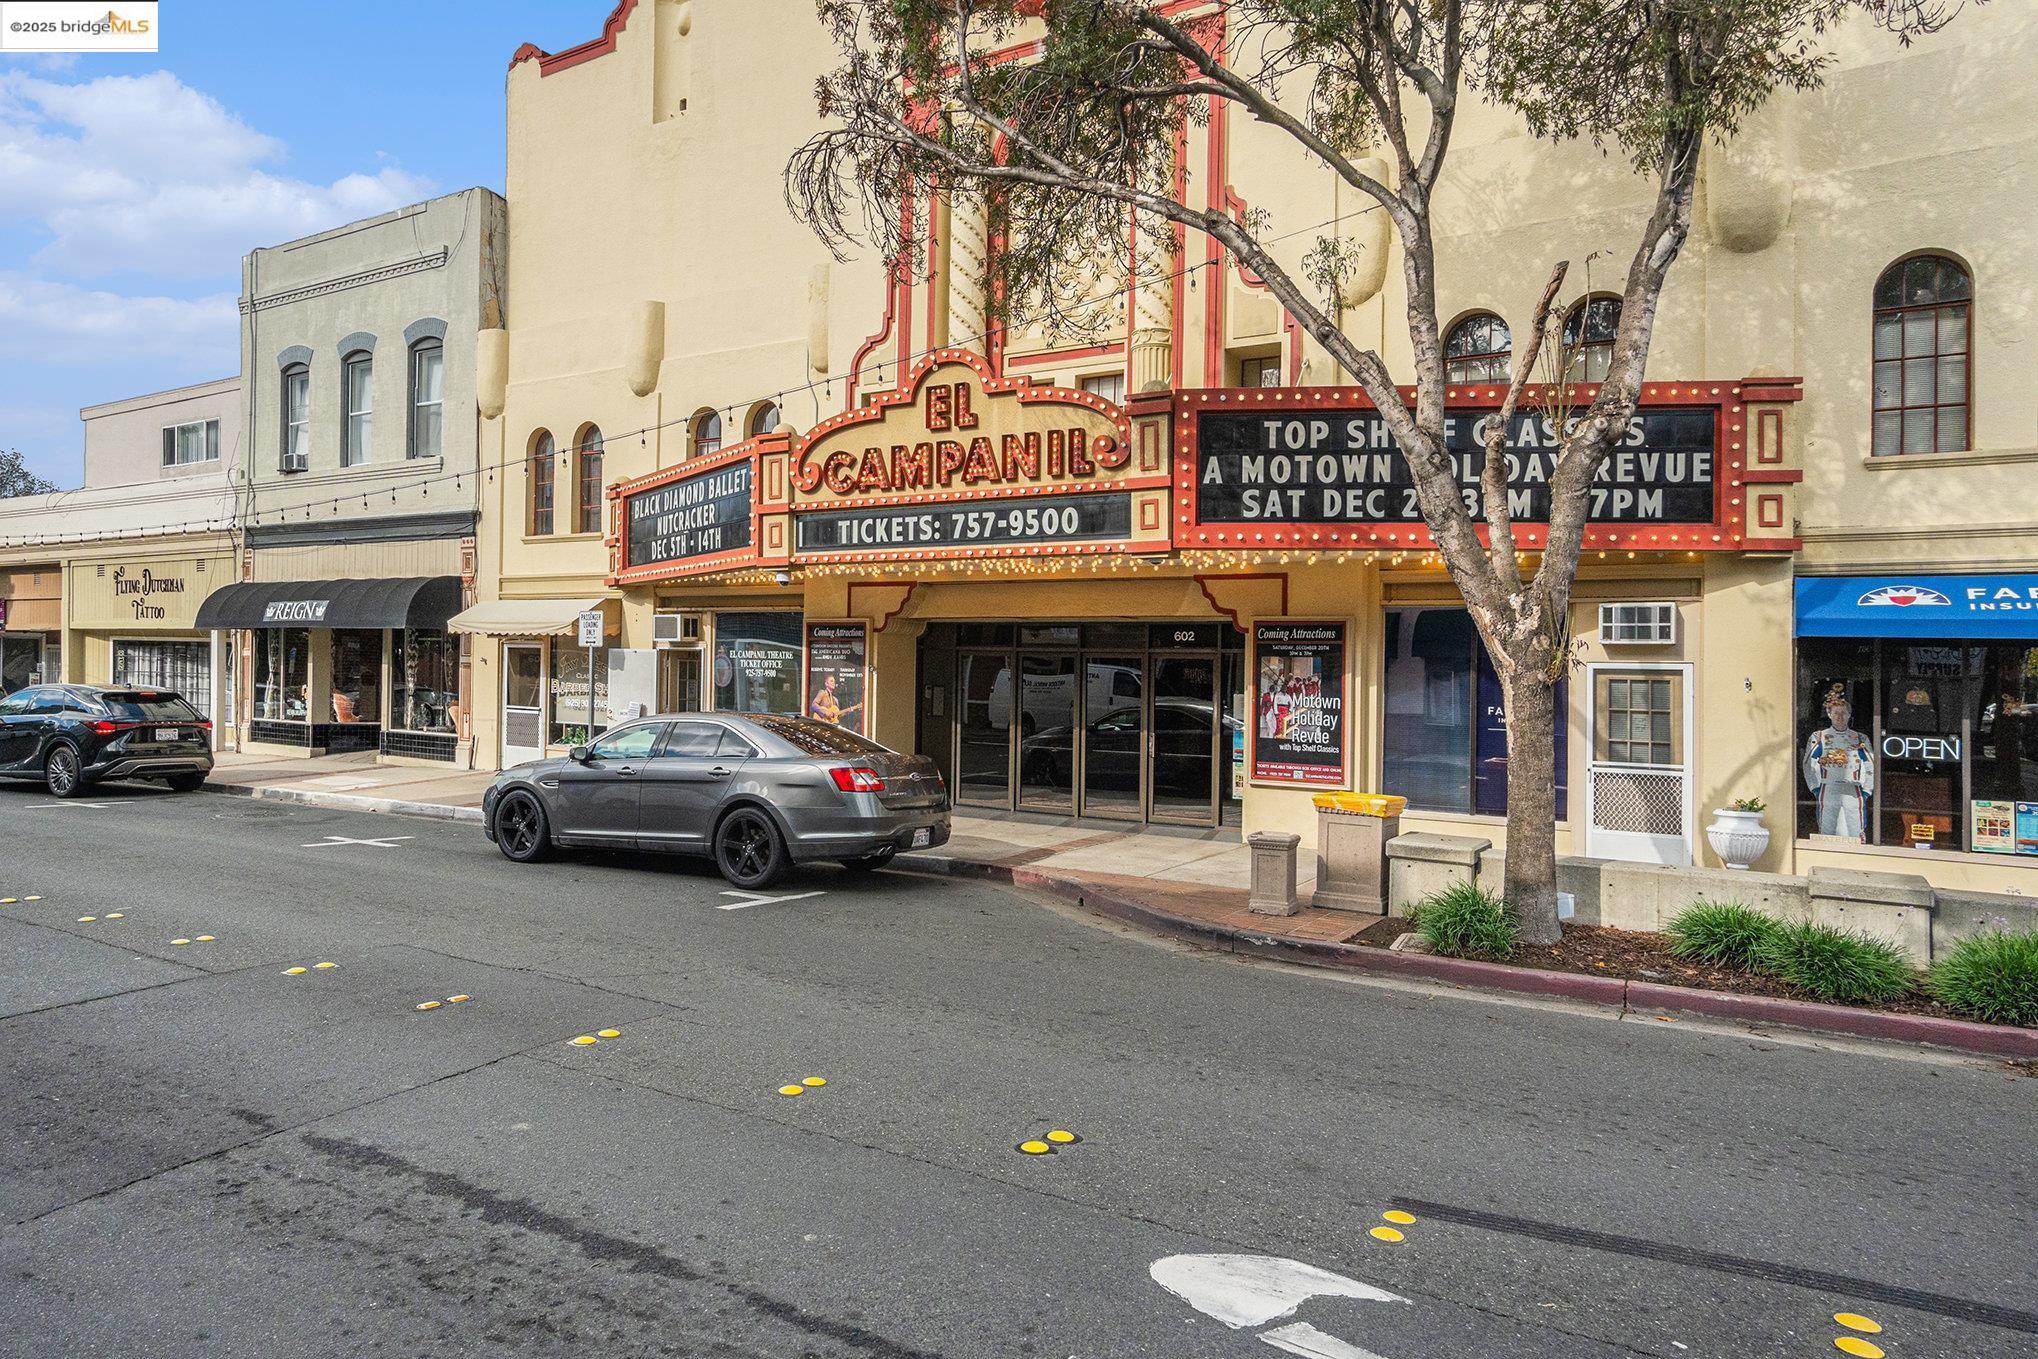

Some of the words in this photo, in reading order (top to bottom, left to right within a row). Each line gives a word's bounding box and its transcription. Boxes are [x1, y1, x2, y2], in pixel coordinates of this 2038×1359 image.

[925, 381, 979, 430] EL
[1264, 420, 1329, 449] TOP
[1346, 419, 1456, 448] SHF
[822, 427, 1094, 493] CAMPANIL
[1203, 455, 1223, 484] A
[1241, 454, 1391, 484] MOTOWN
[1593, 452, 1711, 482] REVUE
[634, 494, 660, 519] BLACK
[664, 481, 705, 511] DIAMOND
[708, 468, 747, 499] BALLET
[1242, 489, 1305, 518] SAT
[1323, 489, 1385, 518] DEC
[1462, 488, 1532, 517] 3M
[1590, 489, 1663, 518] 7PM
[657, 503, 715, 536] NUTCRACKER
[838, 515, 940, 544] TICKETS:
[952, 506, 1079, 539] 757-9500
[651, 539, 667, 560] DEC
[670, 534, 686, 557] 5TH
[698, 527, 720, 552] 14TH
[113, 566, 140, 596] FLYING
[142, 568, 184, 596] DUTCHMAN
[131, 597, 165, 620] TATTOO
[274, 600, 317, 619] REIGN
[1970, 602, 2038, 610] INSU
[814, 627, 835, 638] Coming
[835, 627, 864, 637] Attractions
[1174, 631, 1195, 641] 602
[1258, 628, 1289, 641] Coming
[1290, 628, 1336, 639] Attractions
[730, 650, 737, 658] EL
[737, 650, 766, 659] CAMPANIL
[767, 651, 794, 659] THEATRE
[740, 659, 761, 668] TICKET
[762, 660, 783, 668] OFFICE
[745, 669, 777, 678] 925-757-9500
[594, 682, 608, 693] SH
[1292, 692, 1341, 709] Motown
[1292, 710, 1338, 730] Holiday
[1488, 706, 1504, 716] FA
[1292, 727, 1330, 744] Revue
[1292, 744, 1301, 752] Top
[1302, 744, 1316, 752] Shelf
[1317, 745, 1340, 753] Classics
[1883, 736, 1960, 760] OPEN
